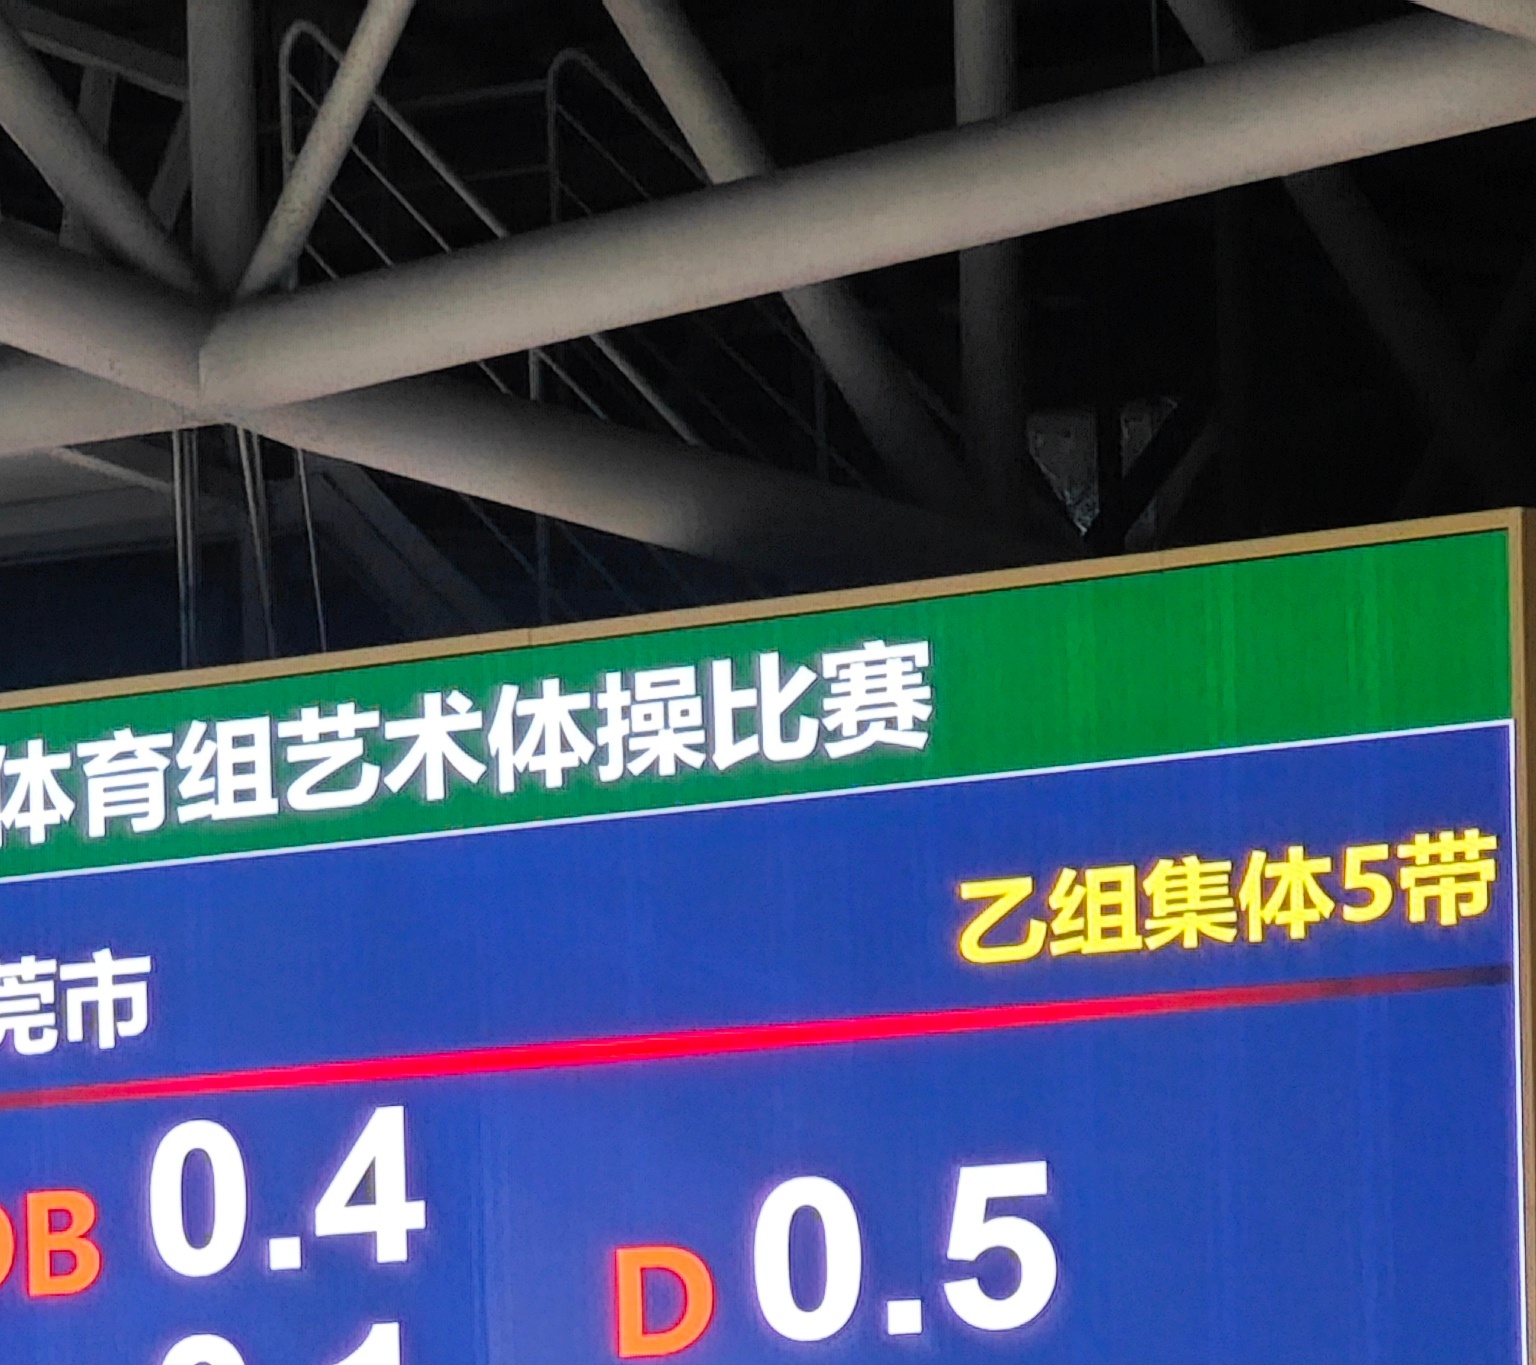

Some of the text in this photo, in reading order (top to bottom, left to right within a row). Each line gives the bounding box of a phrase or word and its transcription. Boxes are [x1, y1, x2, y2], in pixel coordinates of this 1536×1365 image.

[960, 830, 1497, 963] 乙组集体5带
[150, 1106, 425, 1276] 0.4
[614, 1162, 1056, 1358] D 0.5
